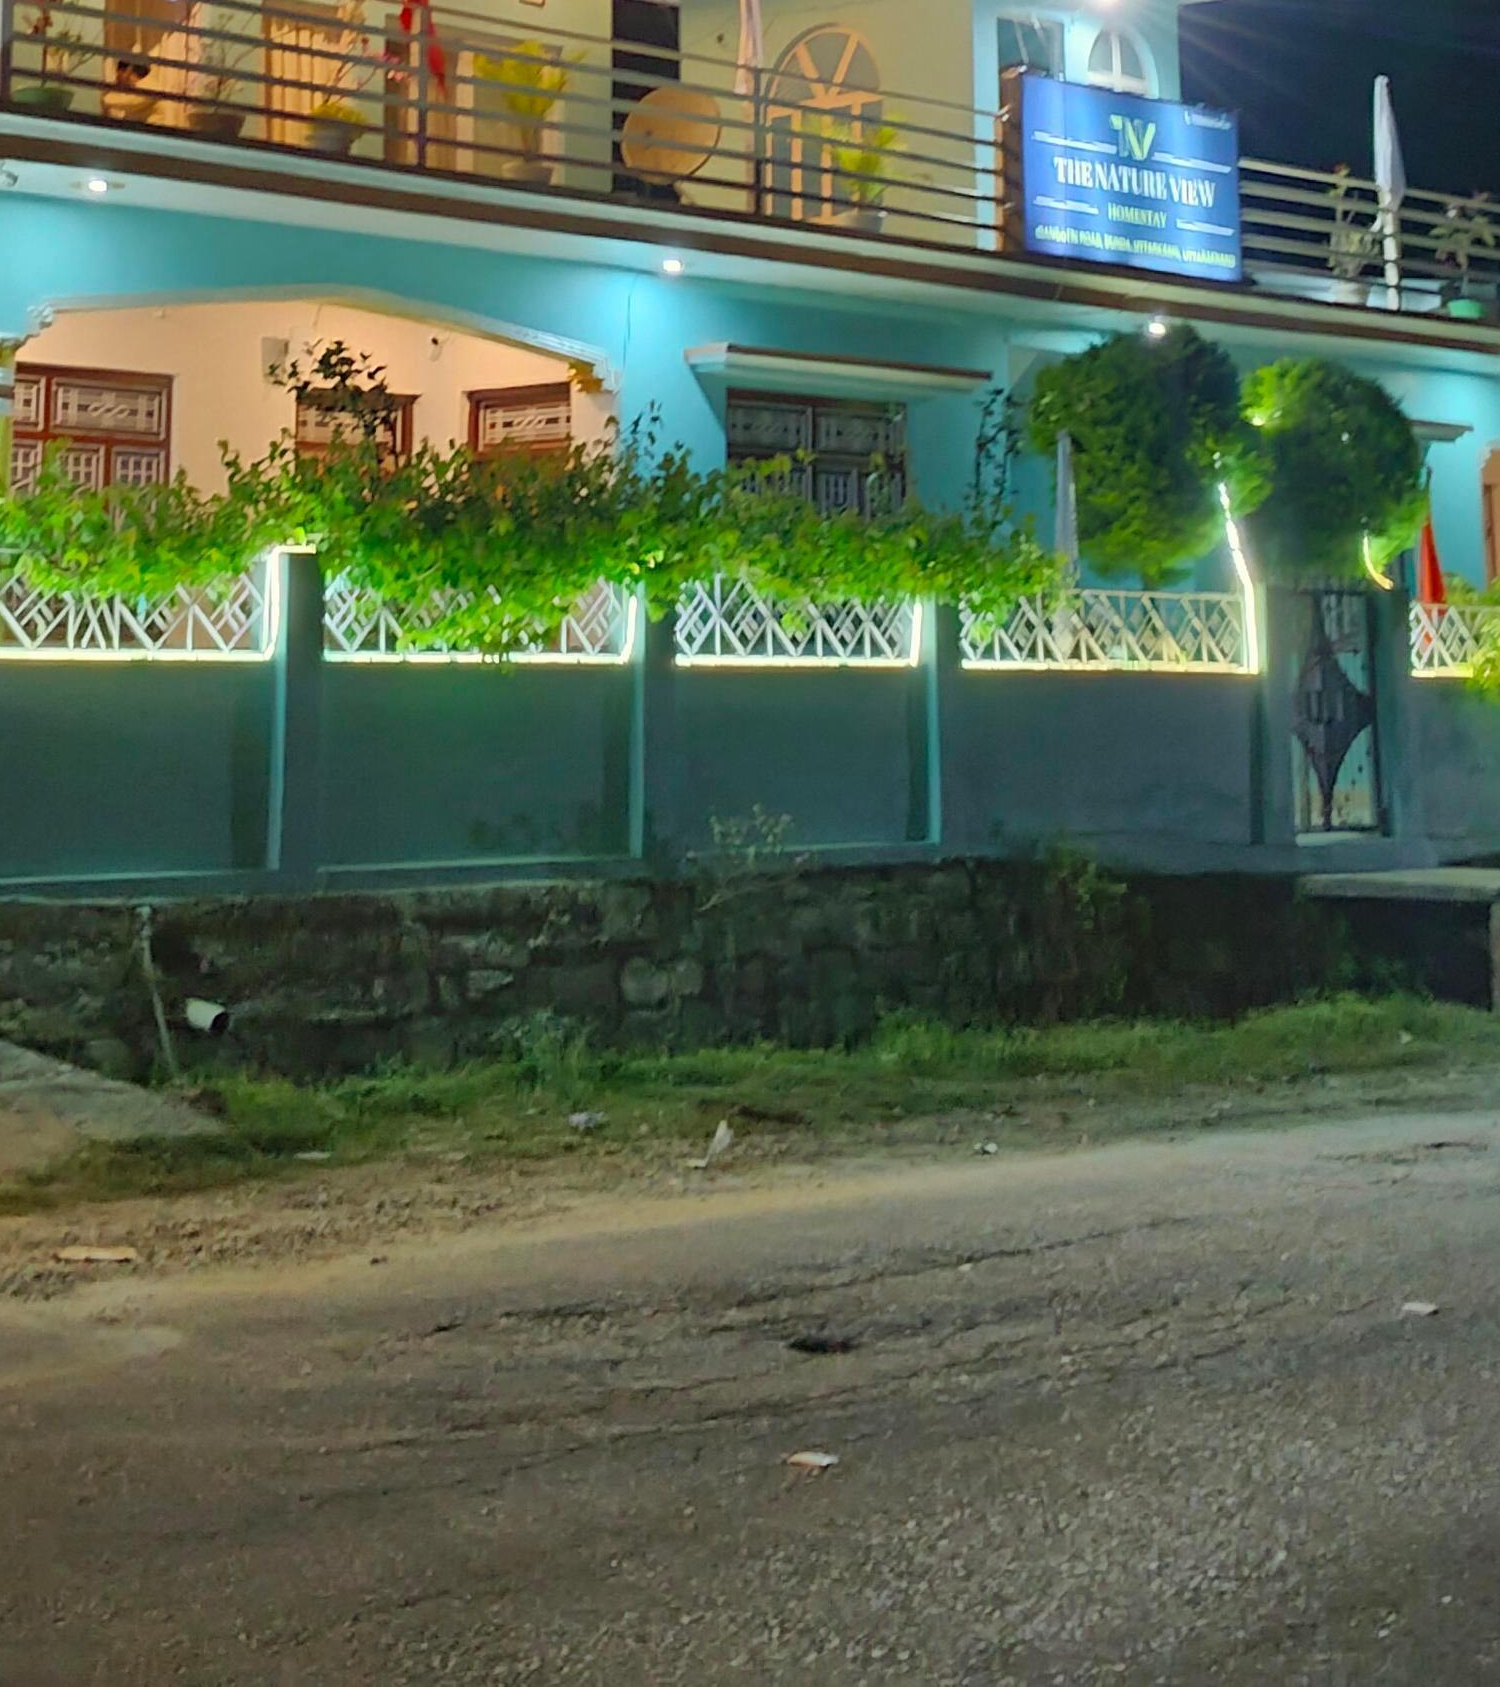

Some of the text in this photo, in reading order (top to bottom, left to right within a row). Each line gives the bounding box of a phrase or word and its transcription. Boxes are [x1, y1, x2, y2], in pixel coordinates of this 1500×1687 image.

[1053, 156, 1216, 208] THE NATURE VIEW
[1107, 202, 1167, 229] HOMESTAY
